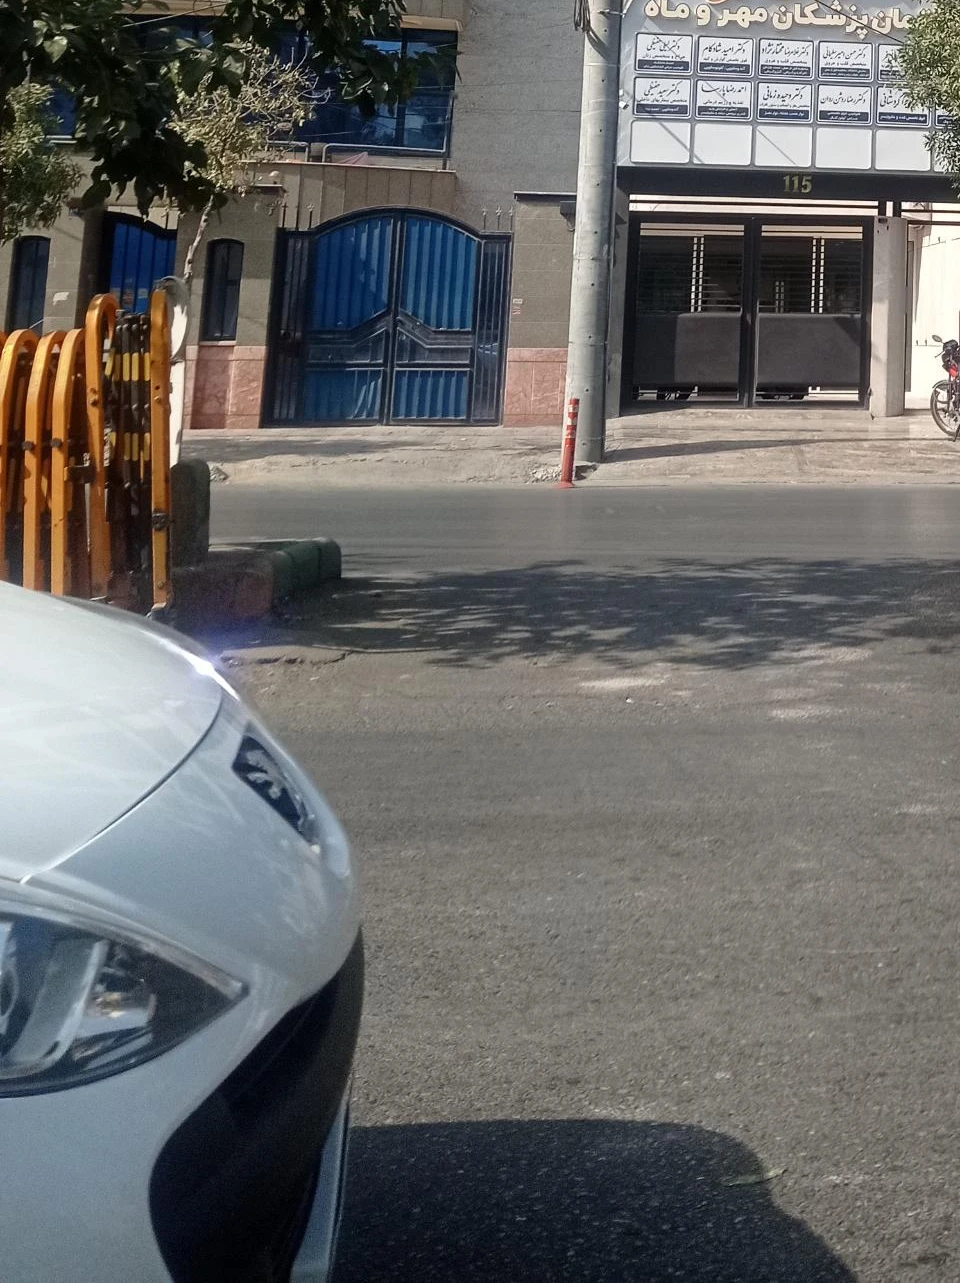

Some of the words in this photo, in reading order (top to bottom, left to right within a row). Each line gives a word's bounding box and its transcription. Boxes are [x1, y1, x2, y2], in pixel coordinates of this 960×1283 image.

[696, 4, 711, 27] و
[717, 6, 768, 28] مهر
[771, 0, 869, 41] پزشکان
[733, 40, 750, 56] دکتر
[854, 45, 869, 60] دکتر
[665, 80, 684, 97] دکتر
[790, 85, 808, 101] دکتر
[854, 88, 870, 105] دکتر
[783, 172, 812, 193] 115
